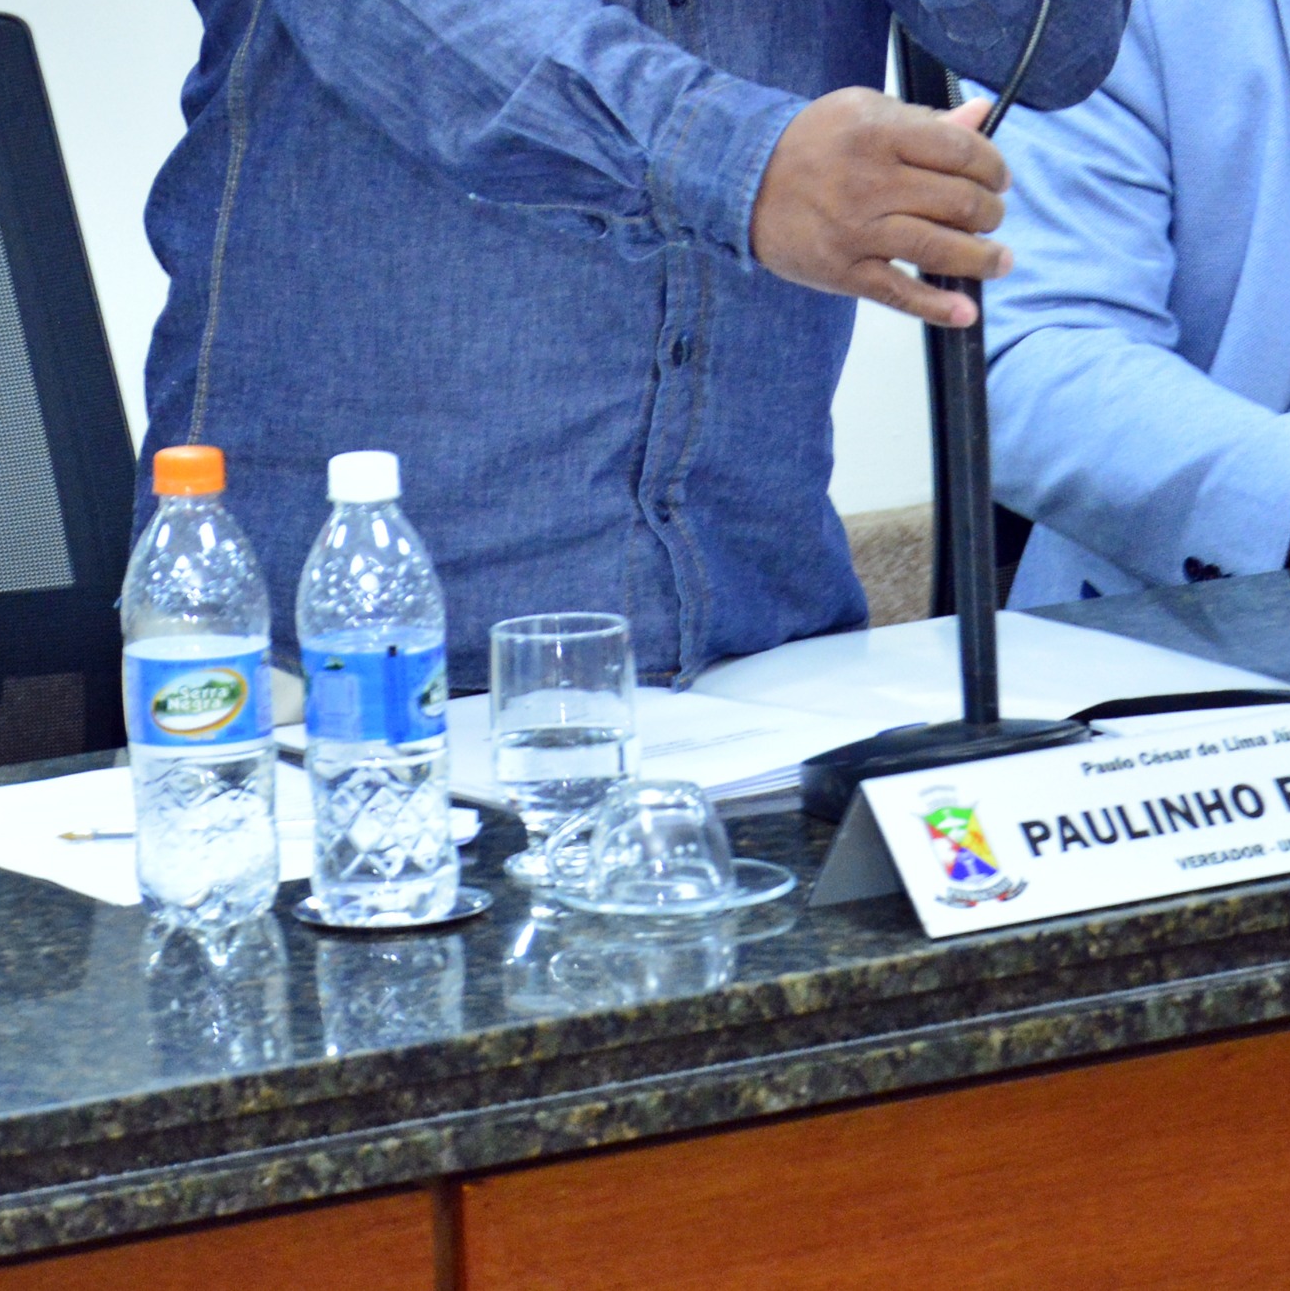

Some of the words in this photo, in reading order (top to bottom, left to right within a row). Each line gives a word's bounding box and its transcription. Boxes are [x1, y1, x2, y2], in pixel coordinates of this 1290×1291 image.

[167, 697, 223, 713] Negra
[178, 685, 229, 700] Serra
[1080, 759, 1135, 777] Paulo
[1197, 743, 1220, 756] de
[1222, 736, 1268, 752] Lima
[1019, 783, 1266, 857] PAULINHO
[1176, 844, 1265, 870] VEREADOR
